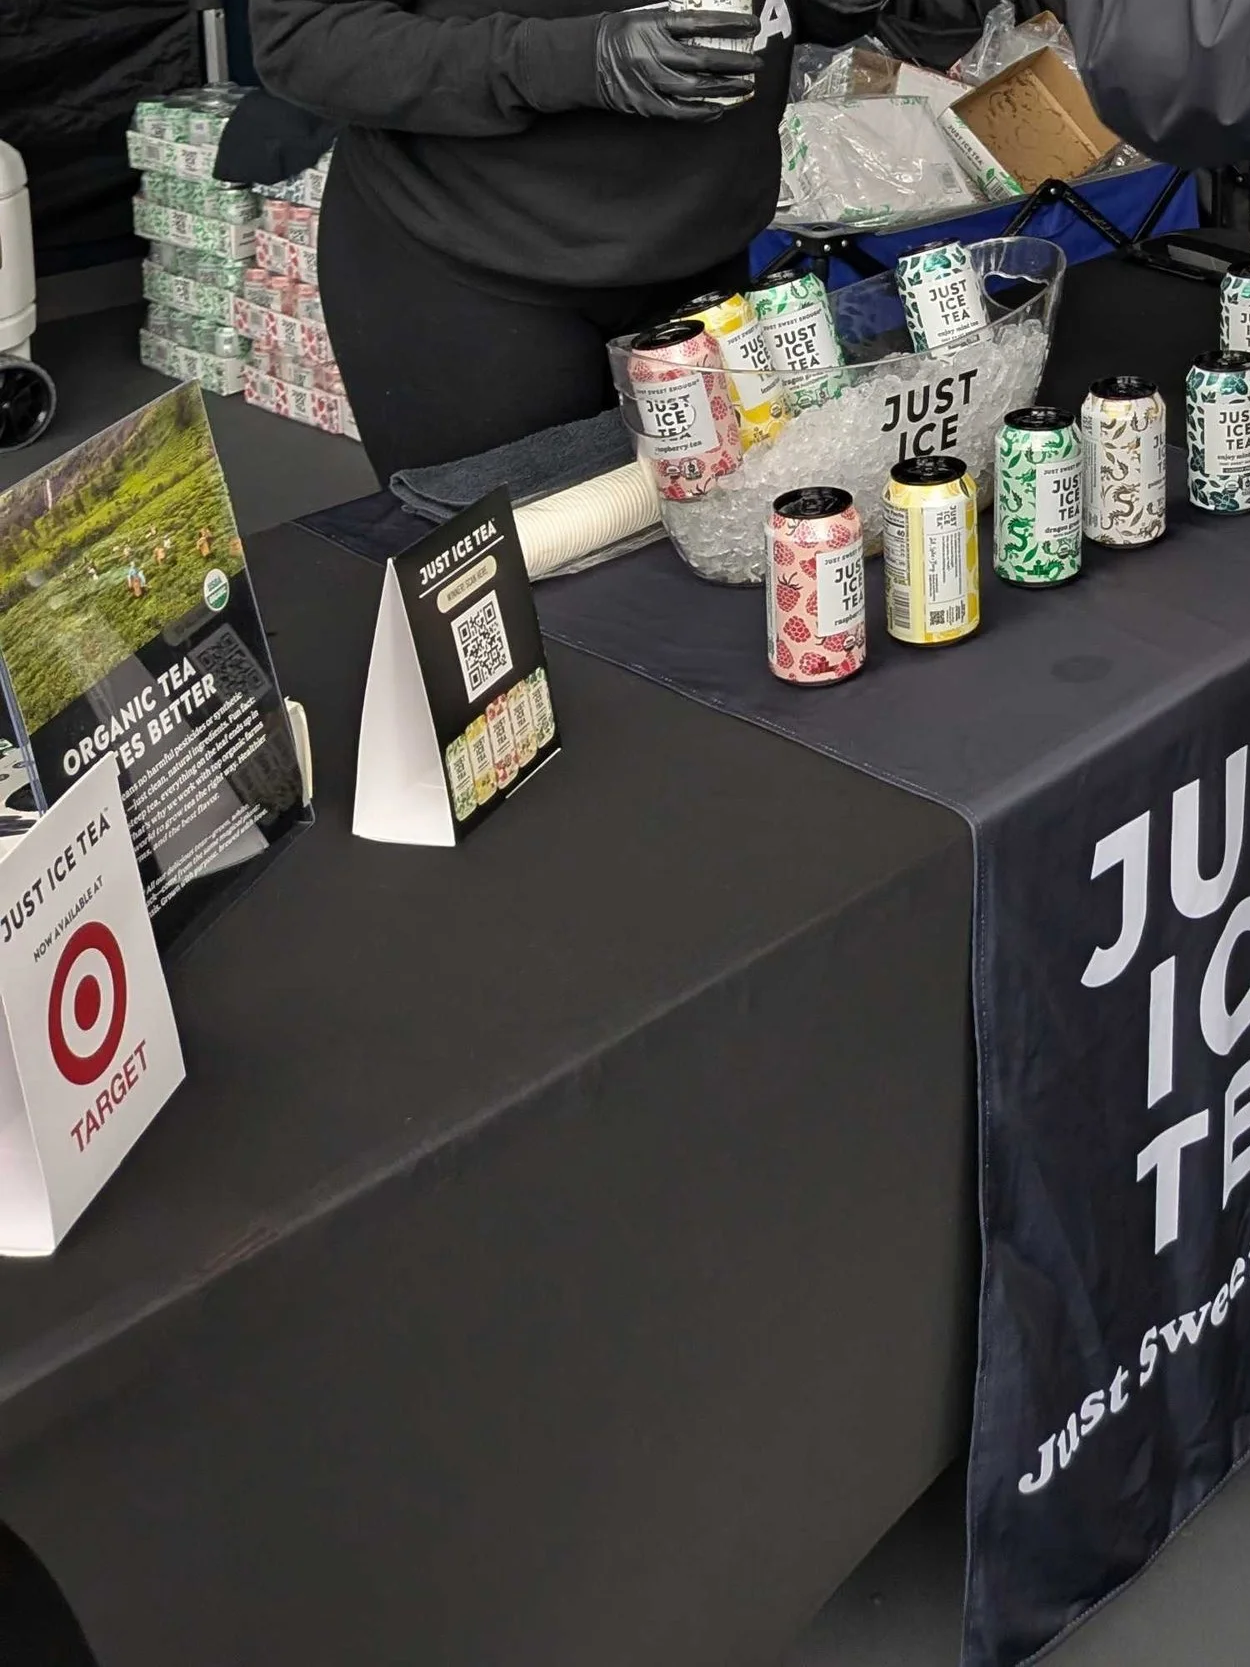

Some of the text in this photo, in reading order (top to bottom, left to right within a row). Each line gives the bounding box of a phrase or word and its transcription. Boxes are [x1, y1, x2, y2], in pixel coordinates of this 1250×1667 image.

[929, 279, 966, 301] JUST
[939, 295, 966, 312] ICE
[942, 310, 970, 325] TEA
[740, 334, 763, 359] JUS
[774, 323, 817, 348] JUST
[785, 340, 815, 359] ICE
[788, 356, 820, 371] TEA
[646, 394, 690, 412] JUST
[655, 410, 686, 427] ICE
[881, 369, 978, 432] JUST
[899, 414, 959, 464] ICE
[1052, 472, 1081, 493] JUS
[420, 550, 450, 585] JUST
[452, 535, 473, 562] ICE
[472, 520, 496, 545] TEA
[834, 559, 862, 583] JUS
[63, 656, 196, 776] ORGANIC TEA
[147, 673, 217, 745] BETTER
[138, 776, 146, 785] no
[146, 750, 174, 777] harmful
[174, 722, 206, 754] pesticides
[213, 691, 242, 720] synthetic
[160, 764, 197, 800] everything
[197, 758, 205, 767] on
[205, 747, 216, 759] the
[215, 735, 228, 749] leaf
[228, 723, 243, 738] ends
[168, 752, 191, 775] natural
[228, 708, 241, 722] Fun
[150, 720, 263, 825] why we work with top organic farms
[164, 810, 182, 827] grow
[184, 799, 195, 809] tea
[195, 788, 207, 800] the
[207, 773, 223, 791] right
[237, 734, 265, 762] Healthier
[152, 835, 167, 848] and
[168, 824, 180, 835] the
[181, 811, 196, 825] best
[0, 878, 44, 943] JUST
[47, 846, 76, 891] ICE
[33, 875, 104, 962] NOW AVAILABLE AT
[70, 1039, 148, 1153] TARGET
[1018, 1369, 1131, 1494] Just
